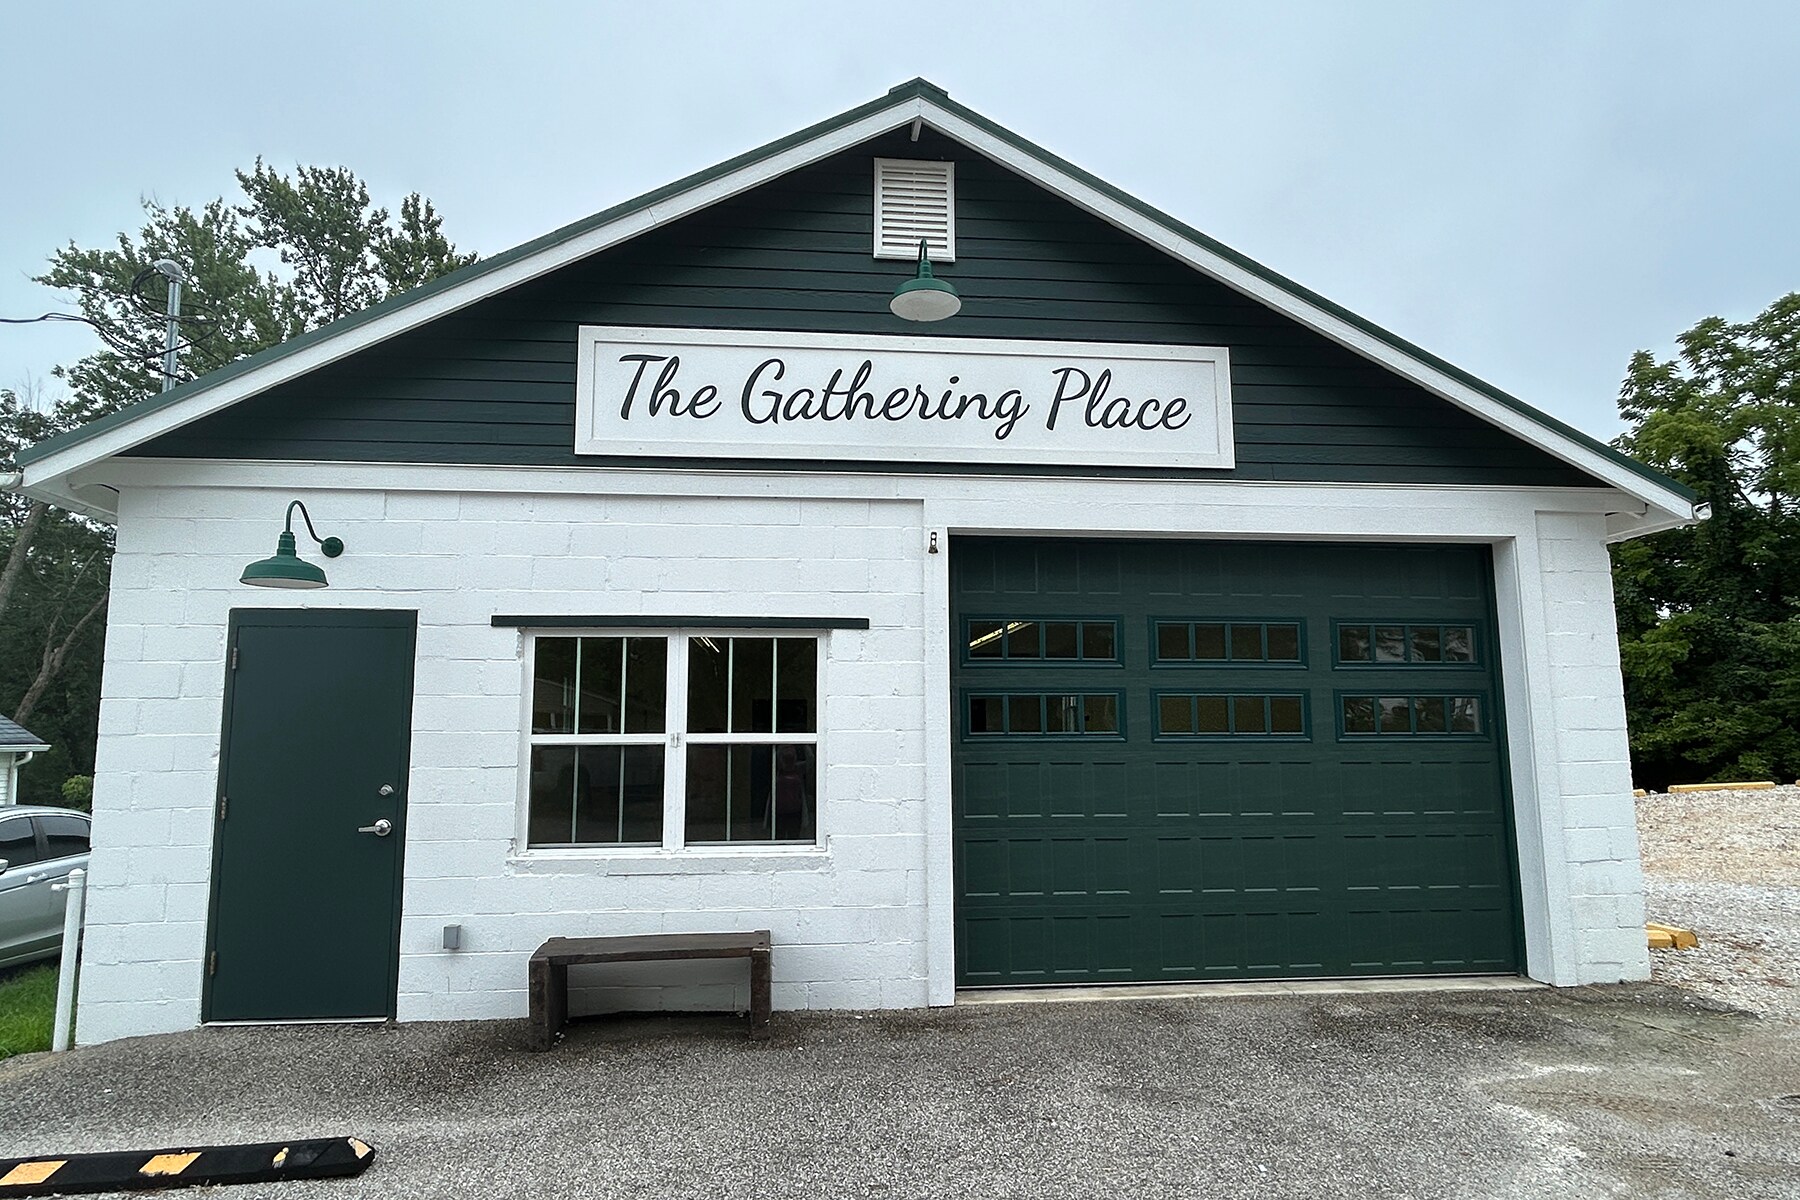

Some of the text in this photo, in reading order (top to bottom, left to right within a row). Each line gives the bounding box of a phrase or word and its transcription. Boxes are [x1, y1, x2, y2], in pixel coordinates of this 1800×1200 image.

[618, 354, 1192, 441] The Gathering Place
